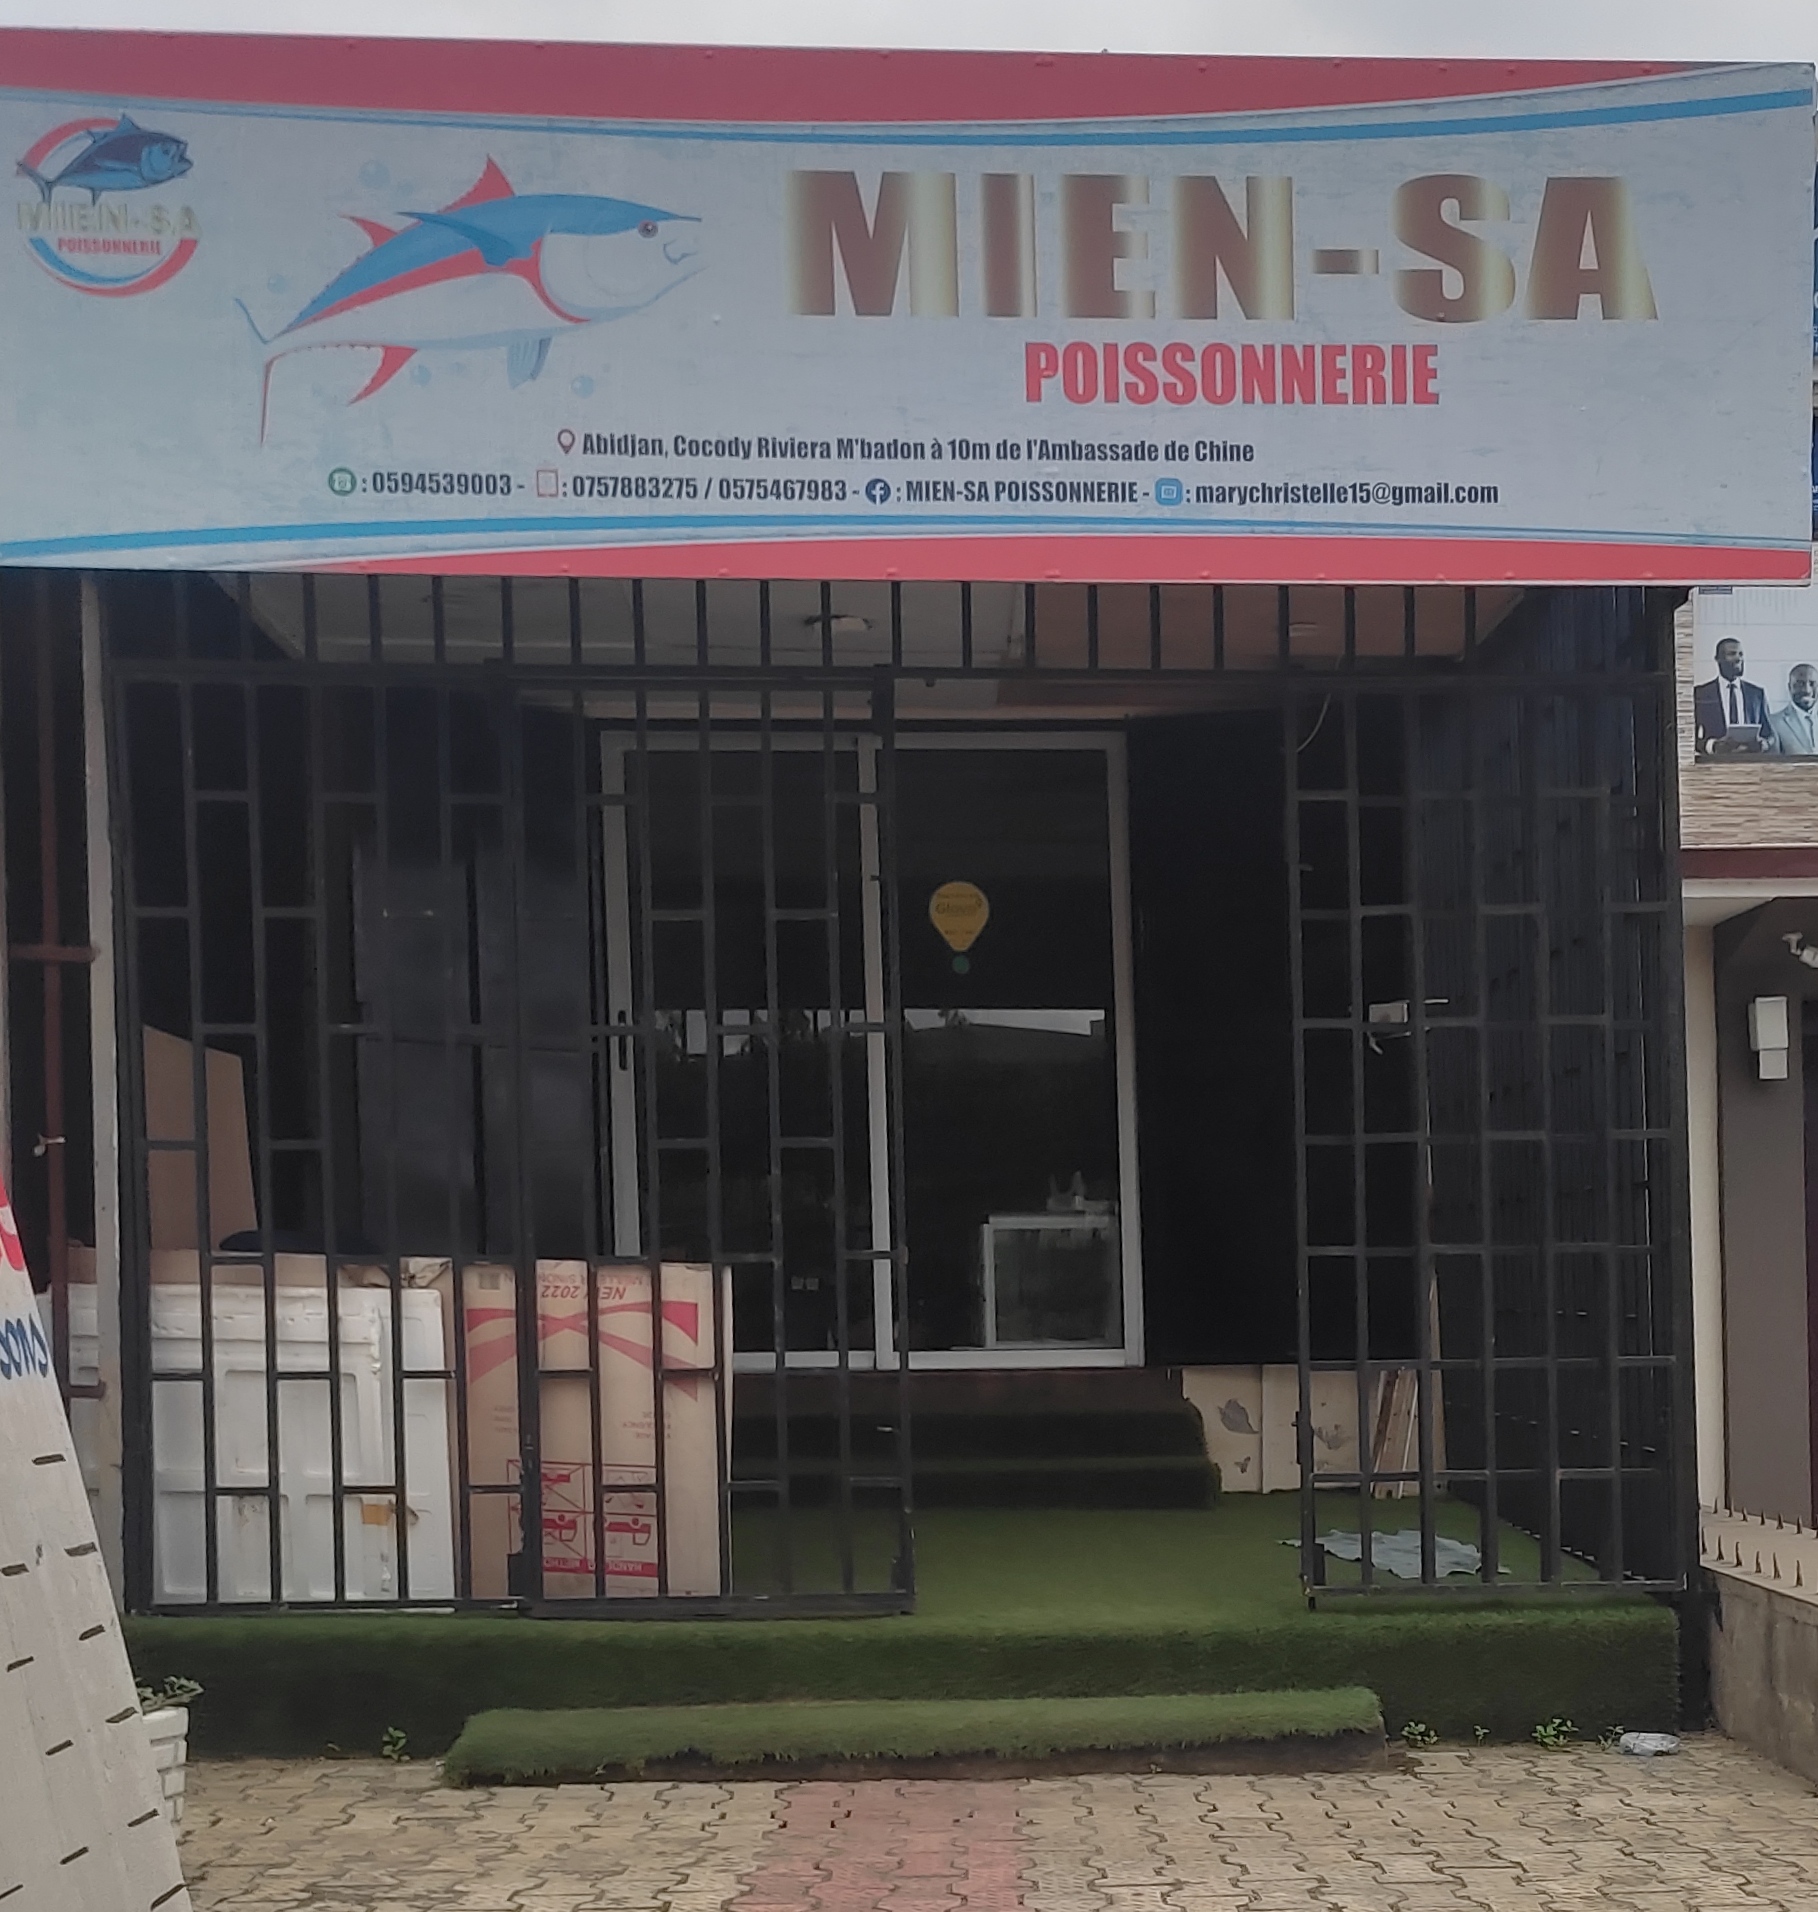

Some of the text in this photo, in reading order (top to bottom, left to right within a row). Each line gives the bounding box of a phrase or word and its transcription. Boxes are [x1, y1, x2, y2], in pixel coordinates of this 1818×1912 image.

[17, 202, 200, 235] MIEN-SA
[786, 169, 1659, 323] MIEN-SA
[1025, 341, 1440, 405] POISSONNERIE
[583, 433, 1254, 462] Abidjan, Cocody Riviera M'badon à 10m de l'Ambassade de Chine
[372, 471, 512, 496] 0594539003
[573, 474, 698, 499] 0757883275
[719, 478, 847, 501] 0575467983
[906, 480, 990, 502] MIEN-SA
[995, 480, 1138, 503] POISSONNERIE
[1196, 481, 1499, 506] marychristelle15@gmail.com
[541, 1285, 581, 1299] 2022
